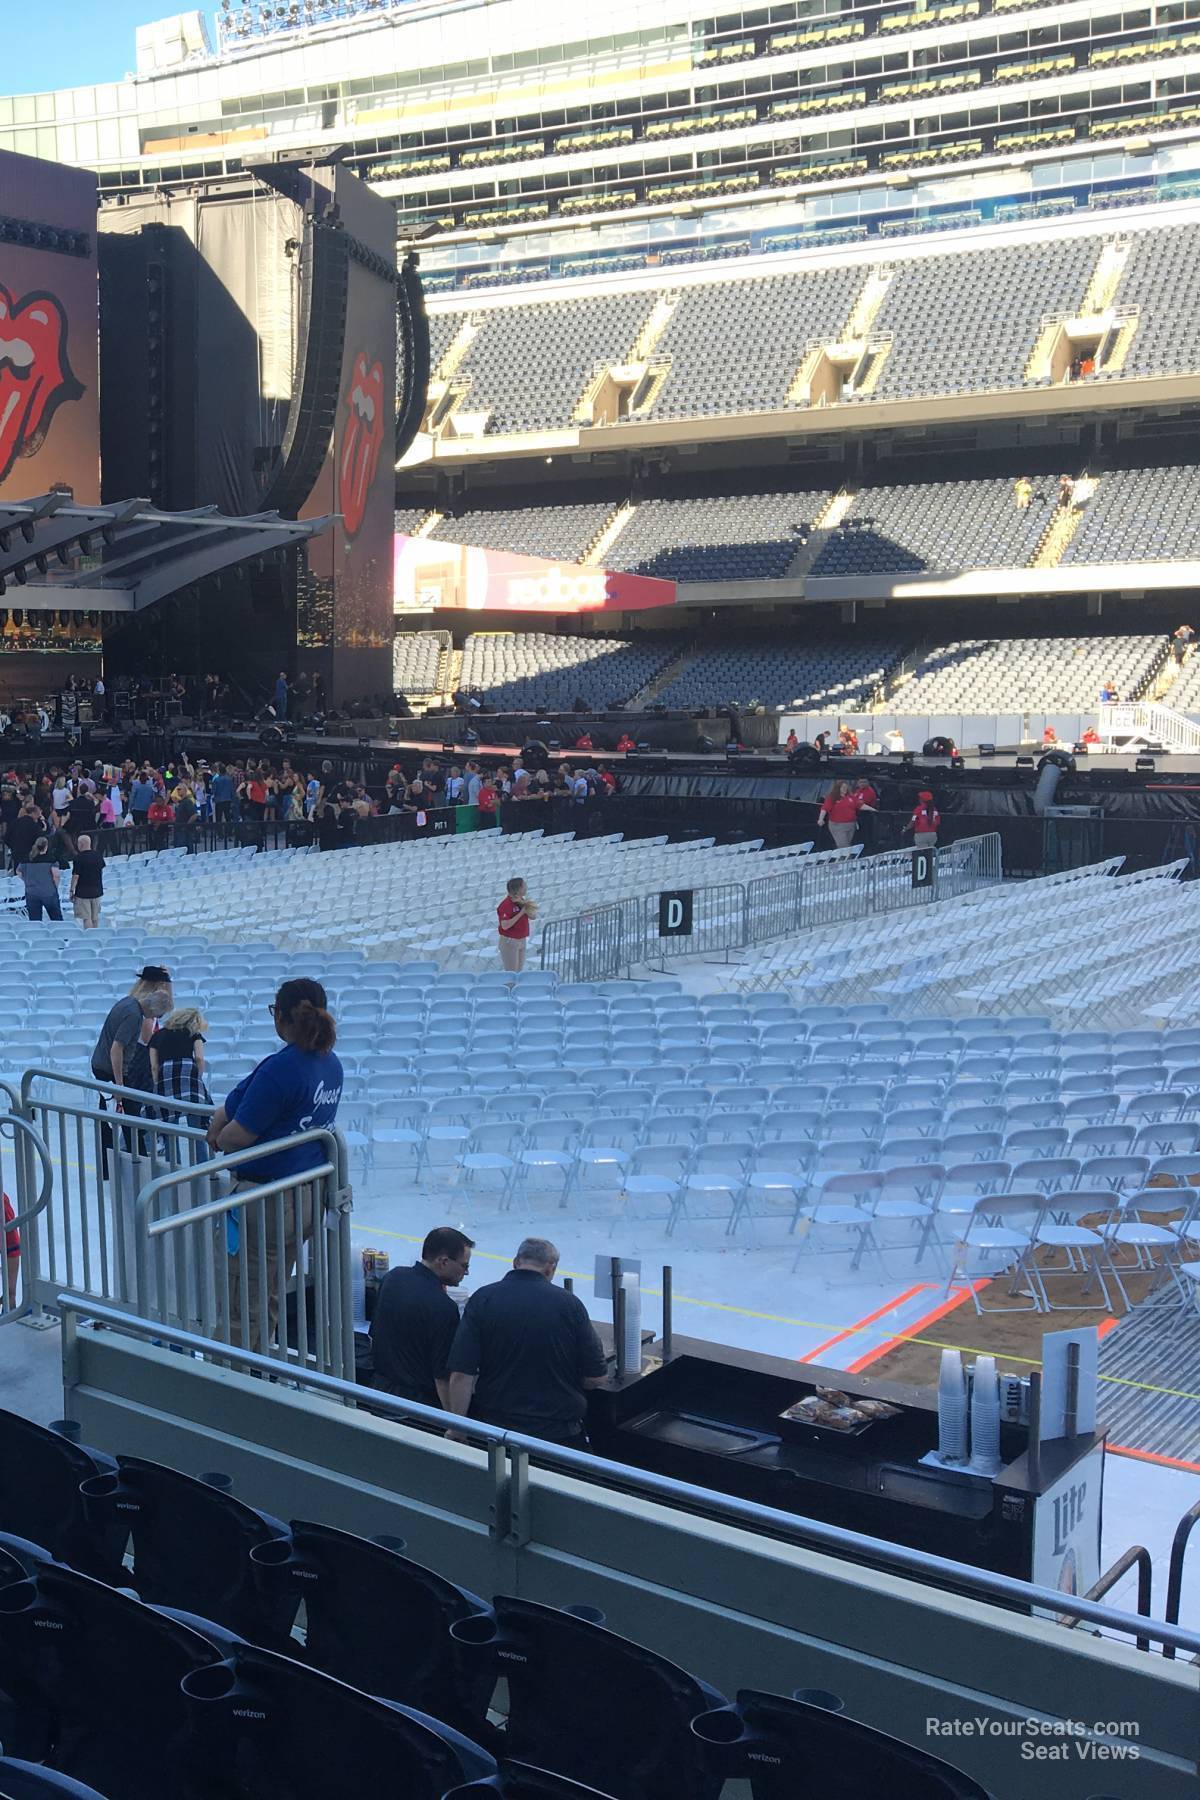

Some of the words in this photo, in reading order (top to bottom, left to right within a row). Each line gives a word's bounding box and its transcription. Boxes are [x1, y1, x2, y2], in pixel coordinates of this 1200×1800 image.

[917, 856, 927, 881] D
[667, 899, 683, 928] D
[1051, 1481, 1087, 1557] Lite
[292, 1568, 319, 1580] verizon
[33, 1618, 63, 1631] verizon
[497, 1648, 528, 1663] verizon
[232, 1707, 266, 1720] verizon
[747, 1751, 781, 1765] verizon
